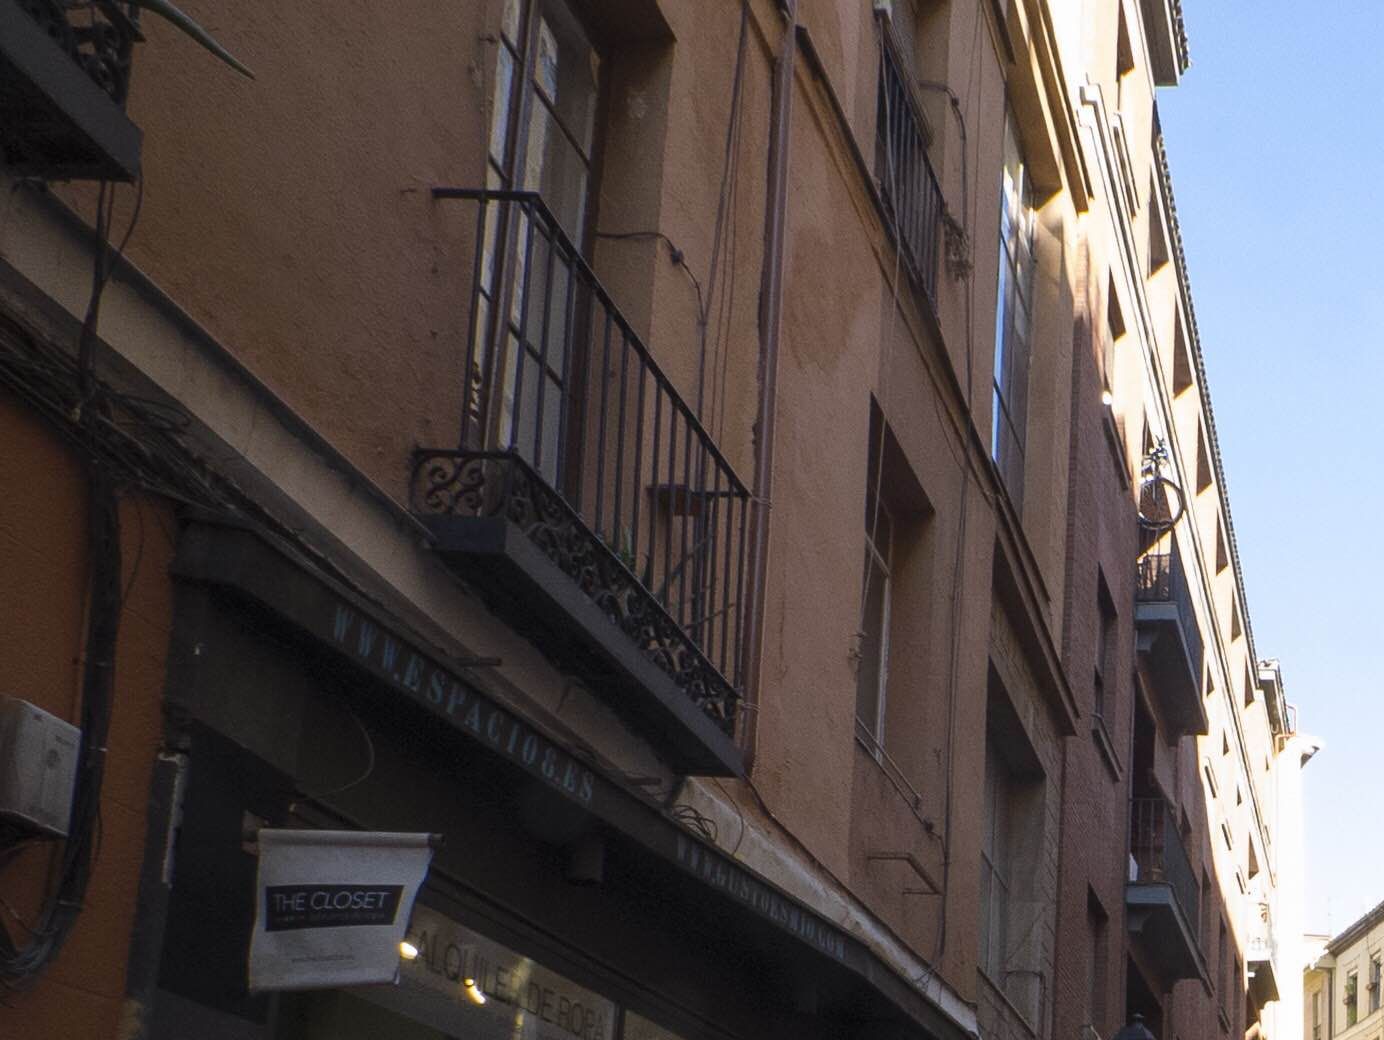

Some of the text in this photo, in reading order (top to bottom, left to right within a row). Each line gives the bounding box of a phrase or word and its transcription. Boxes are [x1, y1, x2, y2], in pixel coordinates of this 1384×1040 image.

[271, 890, 392, 914] THE CLOSET
[414, 929, 525, 1007] ALQUILE
